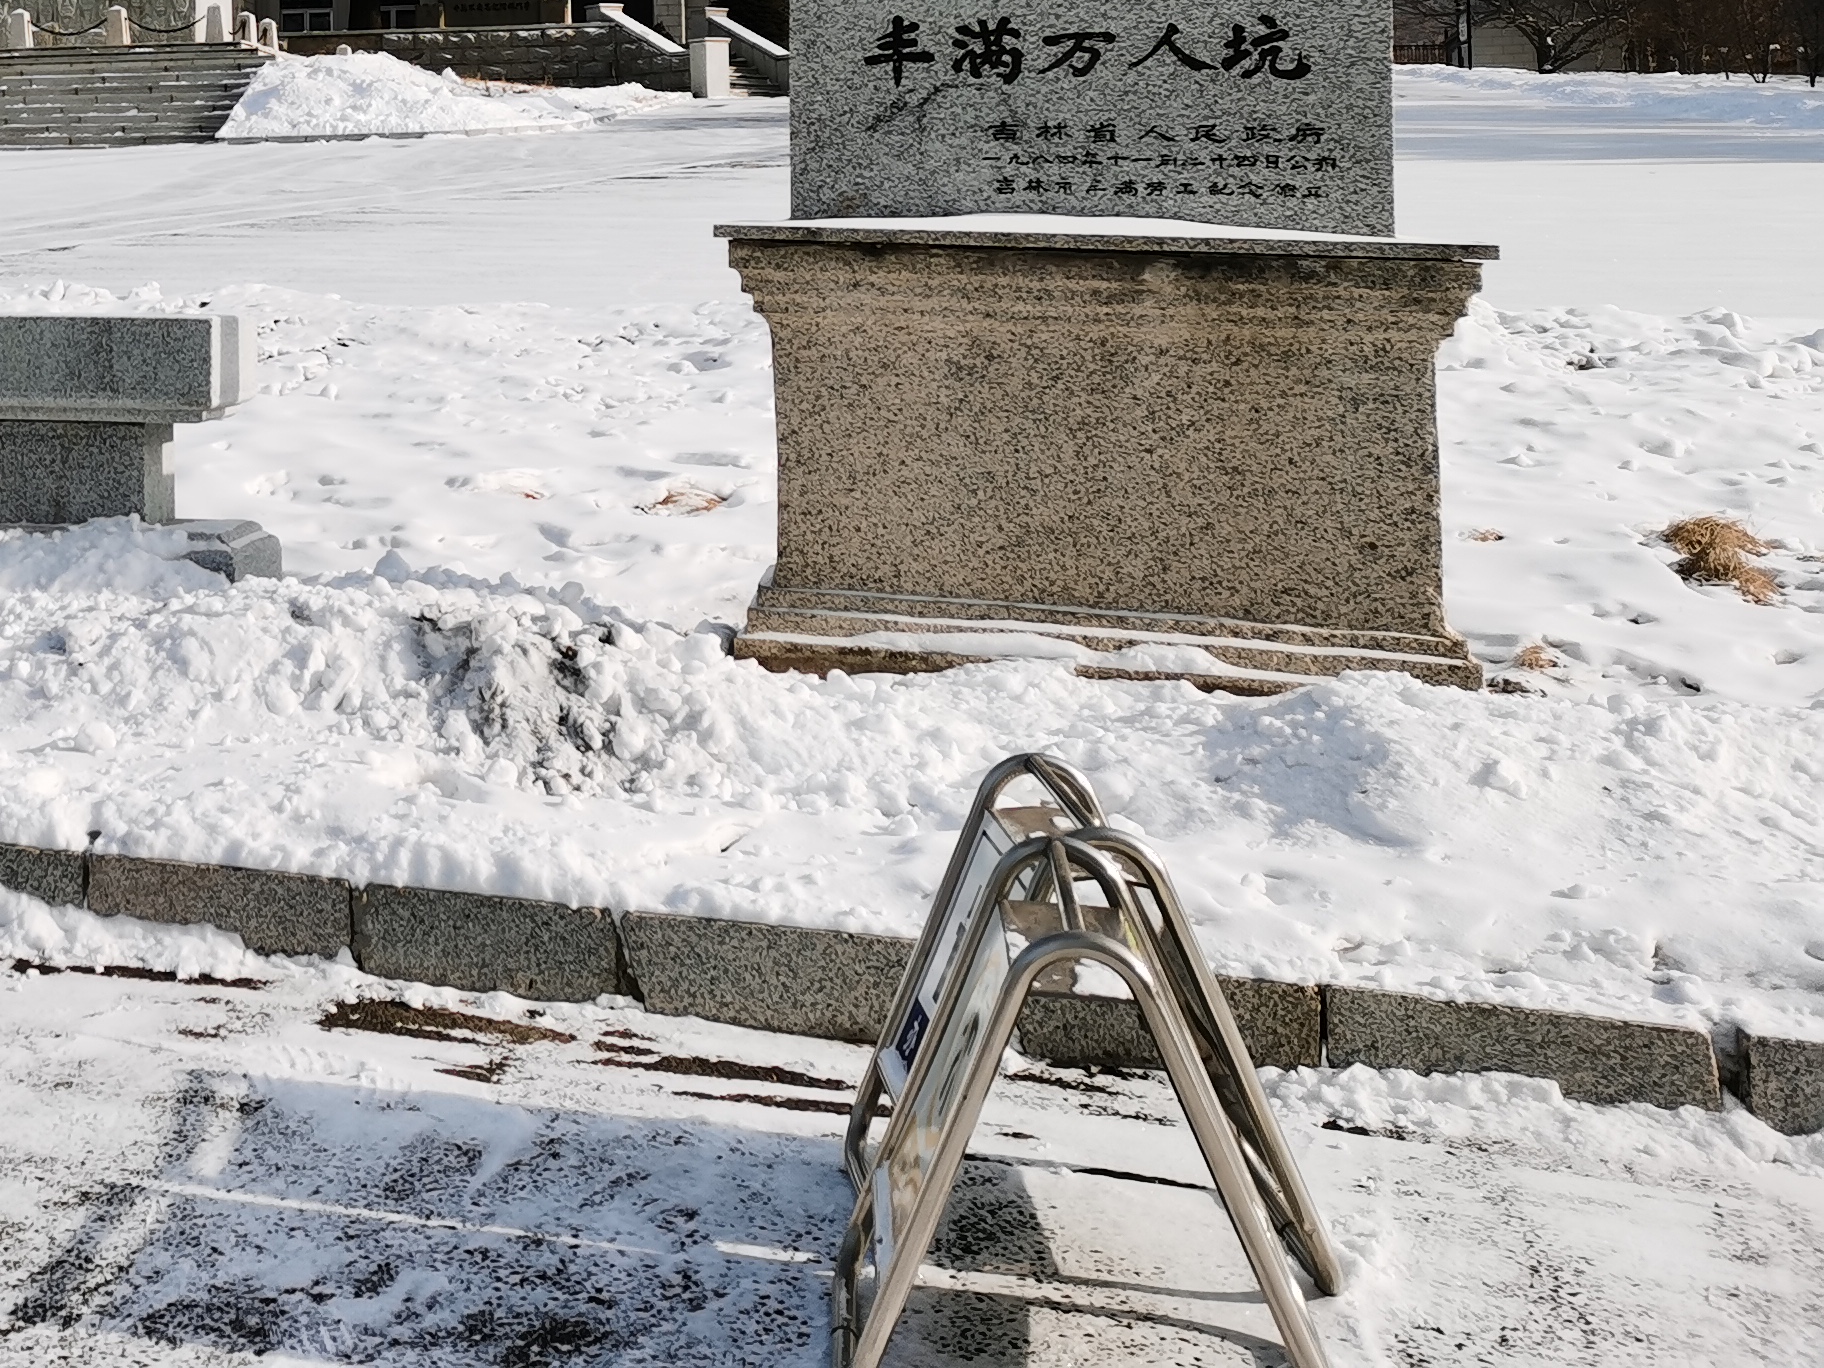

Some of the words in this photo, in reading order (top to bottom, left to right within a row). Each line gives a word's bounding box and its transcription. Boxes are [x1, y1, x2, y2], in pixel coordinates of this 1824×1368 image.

[863, 12, 1313, 88] 丰满万人坑
[987, 120, 1326, 145] 吉林省人民政府
